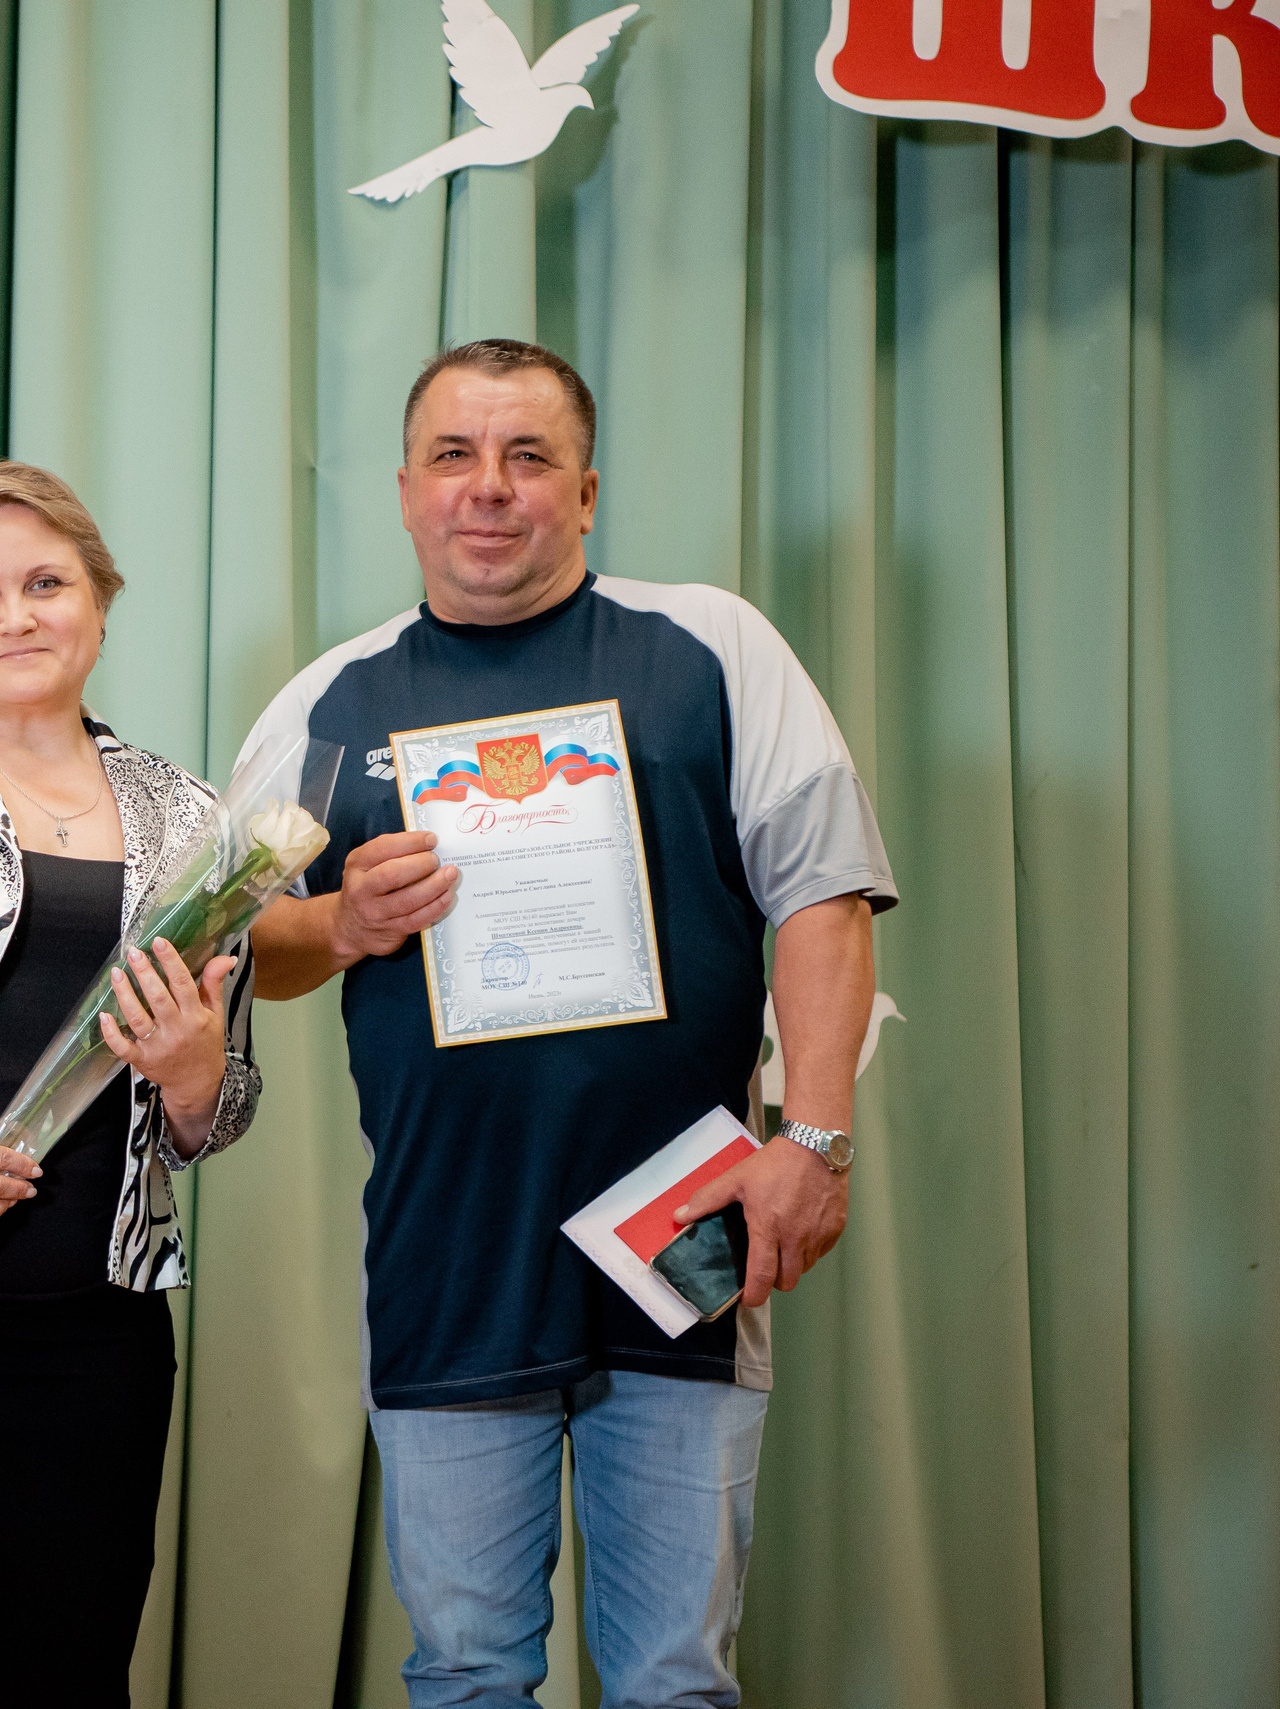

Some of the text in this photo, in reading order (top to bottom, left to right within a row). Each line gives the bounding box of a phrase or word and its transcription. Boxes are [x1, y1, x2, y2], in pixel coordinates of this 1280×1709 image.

[366, 746, 393, 765] are
[442, 852, 496, 862] МУНИЦИПАЛЬНОЕ
[497, 843, 572, 856] ОБЩЕОБРАЗОВАТЕЛЬНОЕ
[511, 851, 551, 861] СОВЕТСКОГО
[551, 848, 576, 856] РАЙОНА
